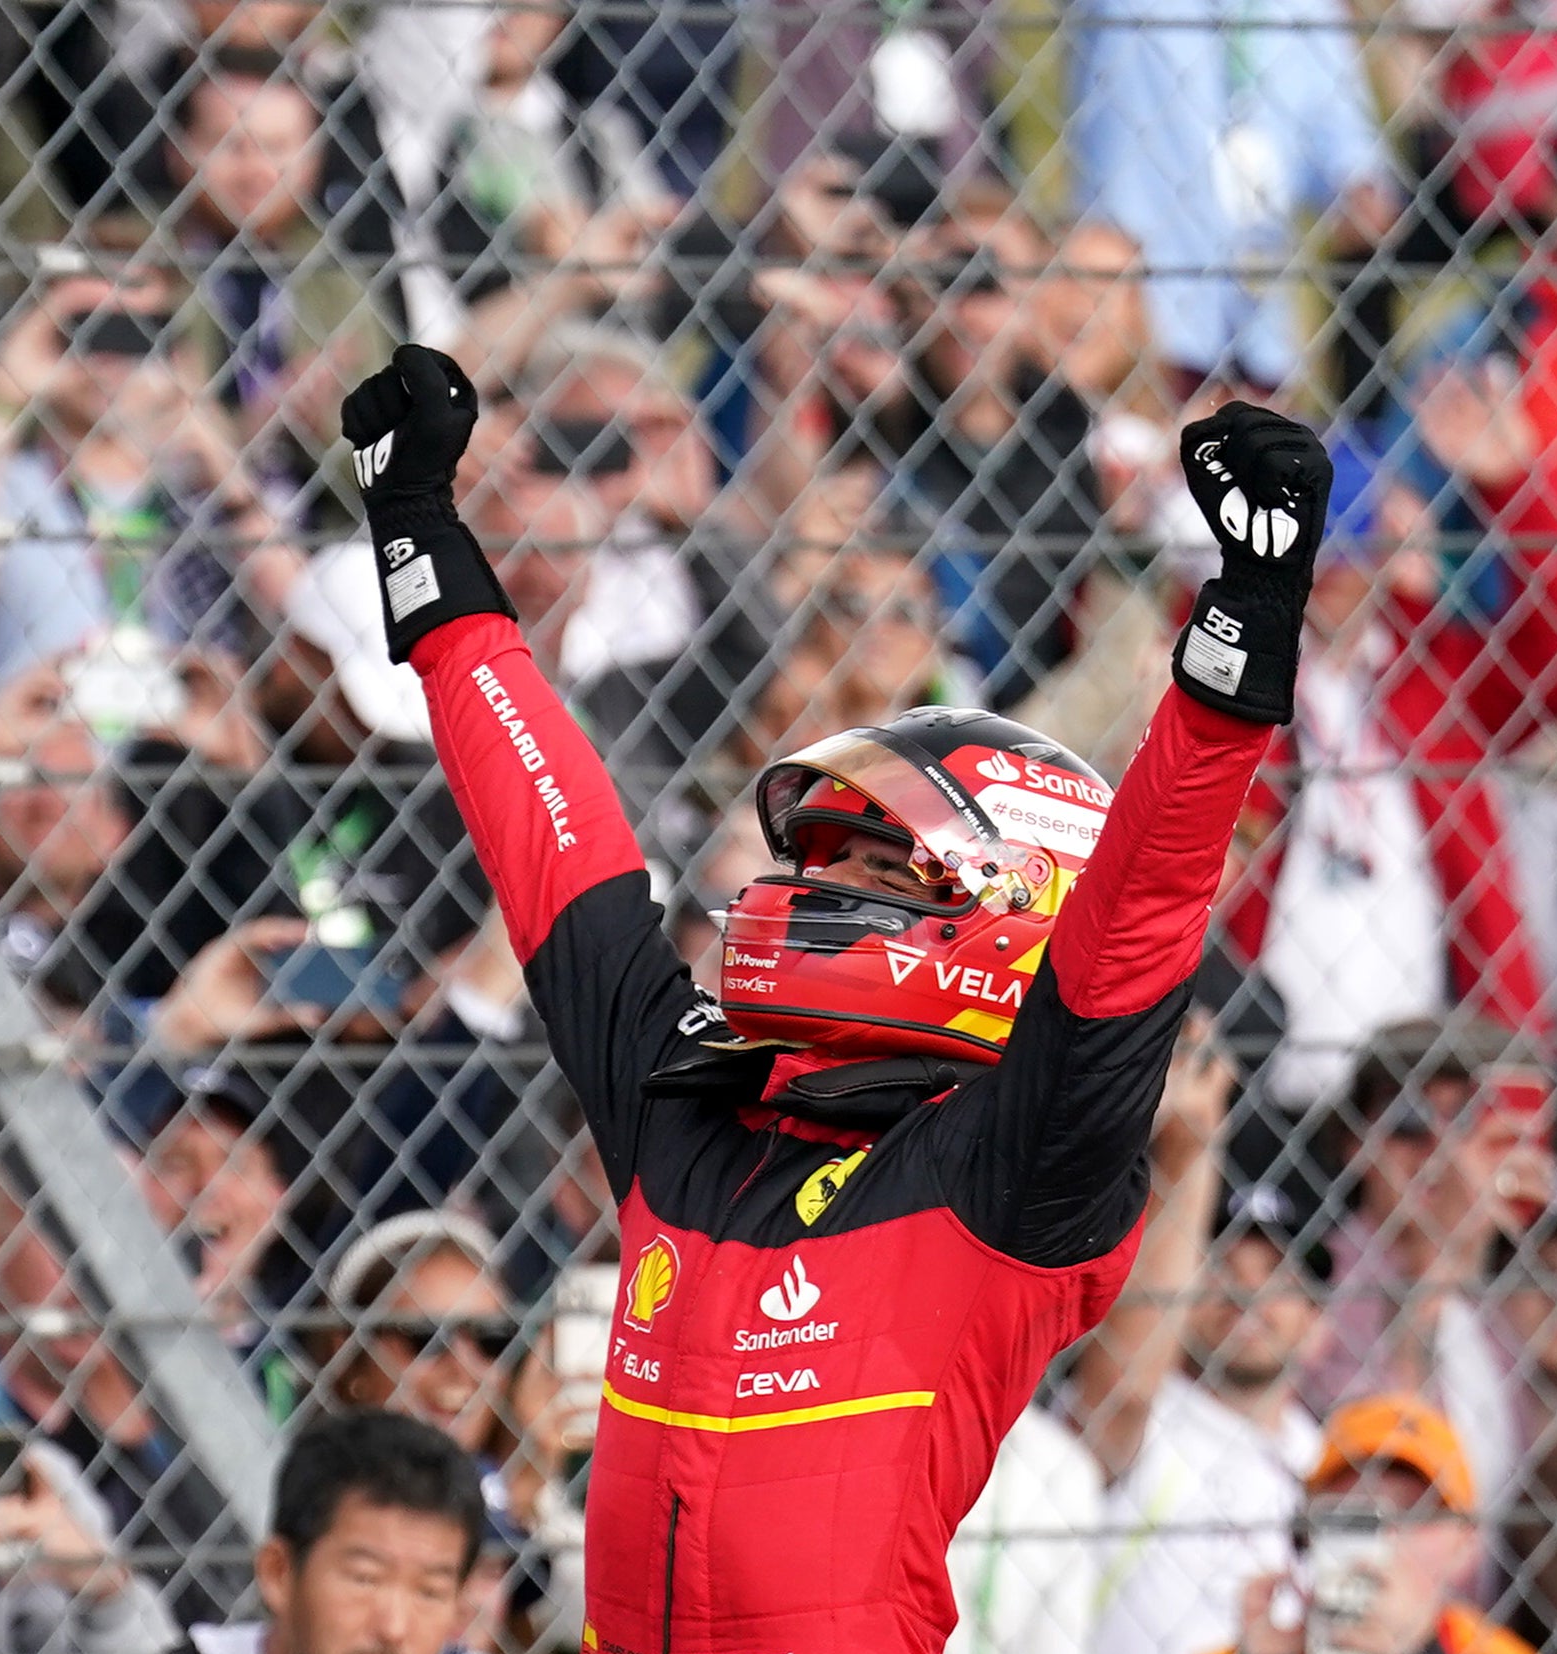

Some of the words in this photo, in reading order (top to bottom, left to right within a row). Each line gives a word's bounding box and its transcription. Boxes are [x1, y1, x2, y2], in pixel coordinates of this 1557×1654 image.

[383, 537, 415, 569] 55
[1203, 605, 1243, 643] 55
[470, 664, 545, 774] RICHARD
[533, 773, 578, 853] MILLE
[924, 765, 965, 809] RICHARD
[962, 807, 990, 841] MILLE
[734, 953, 779, 969] V-Power
[733, 1321, 839, 1351] Santander
